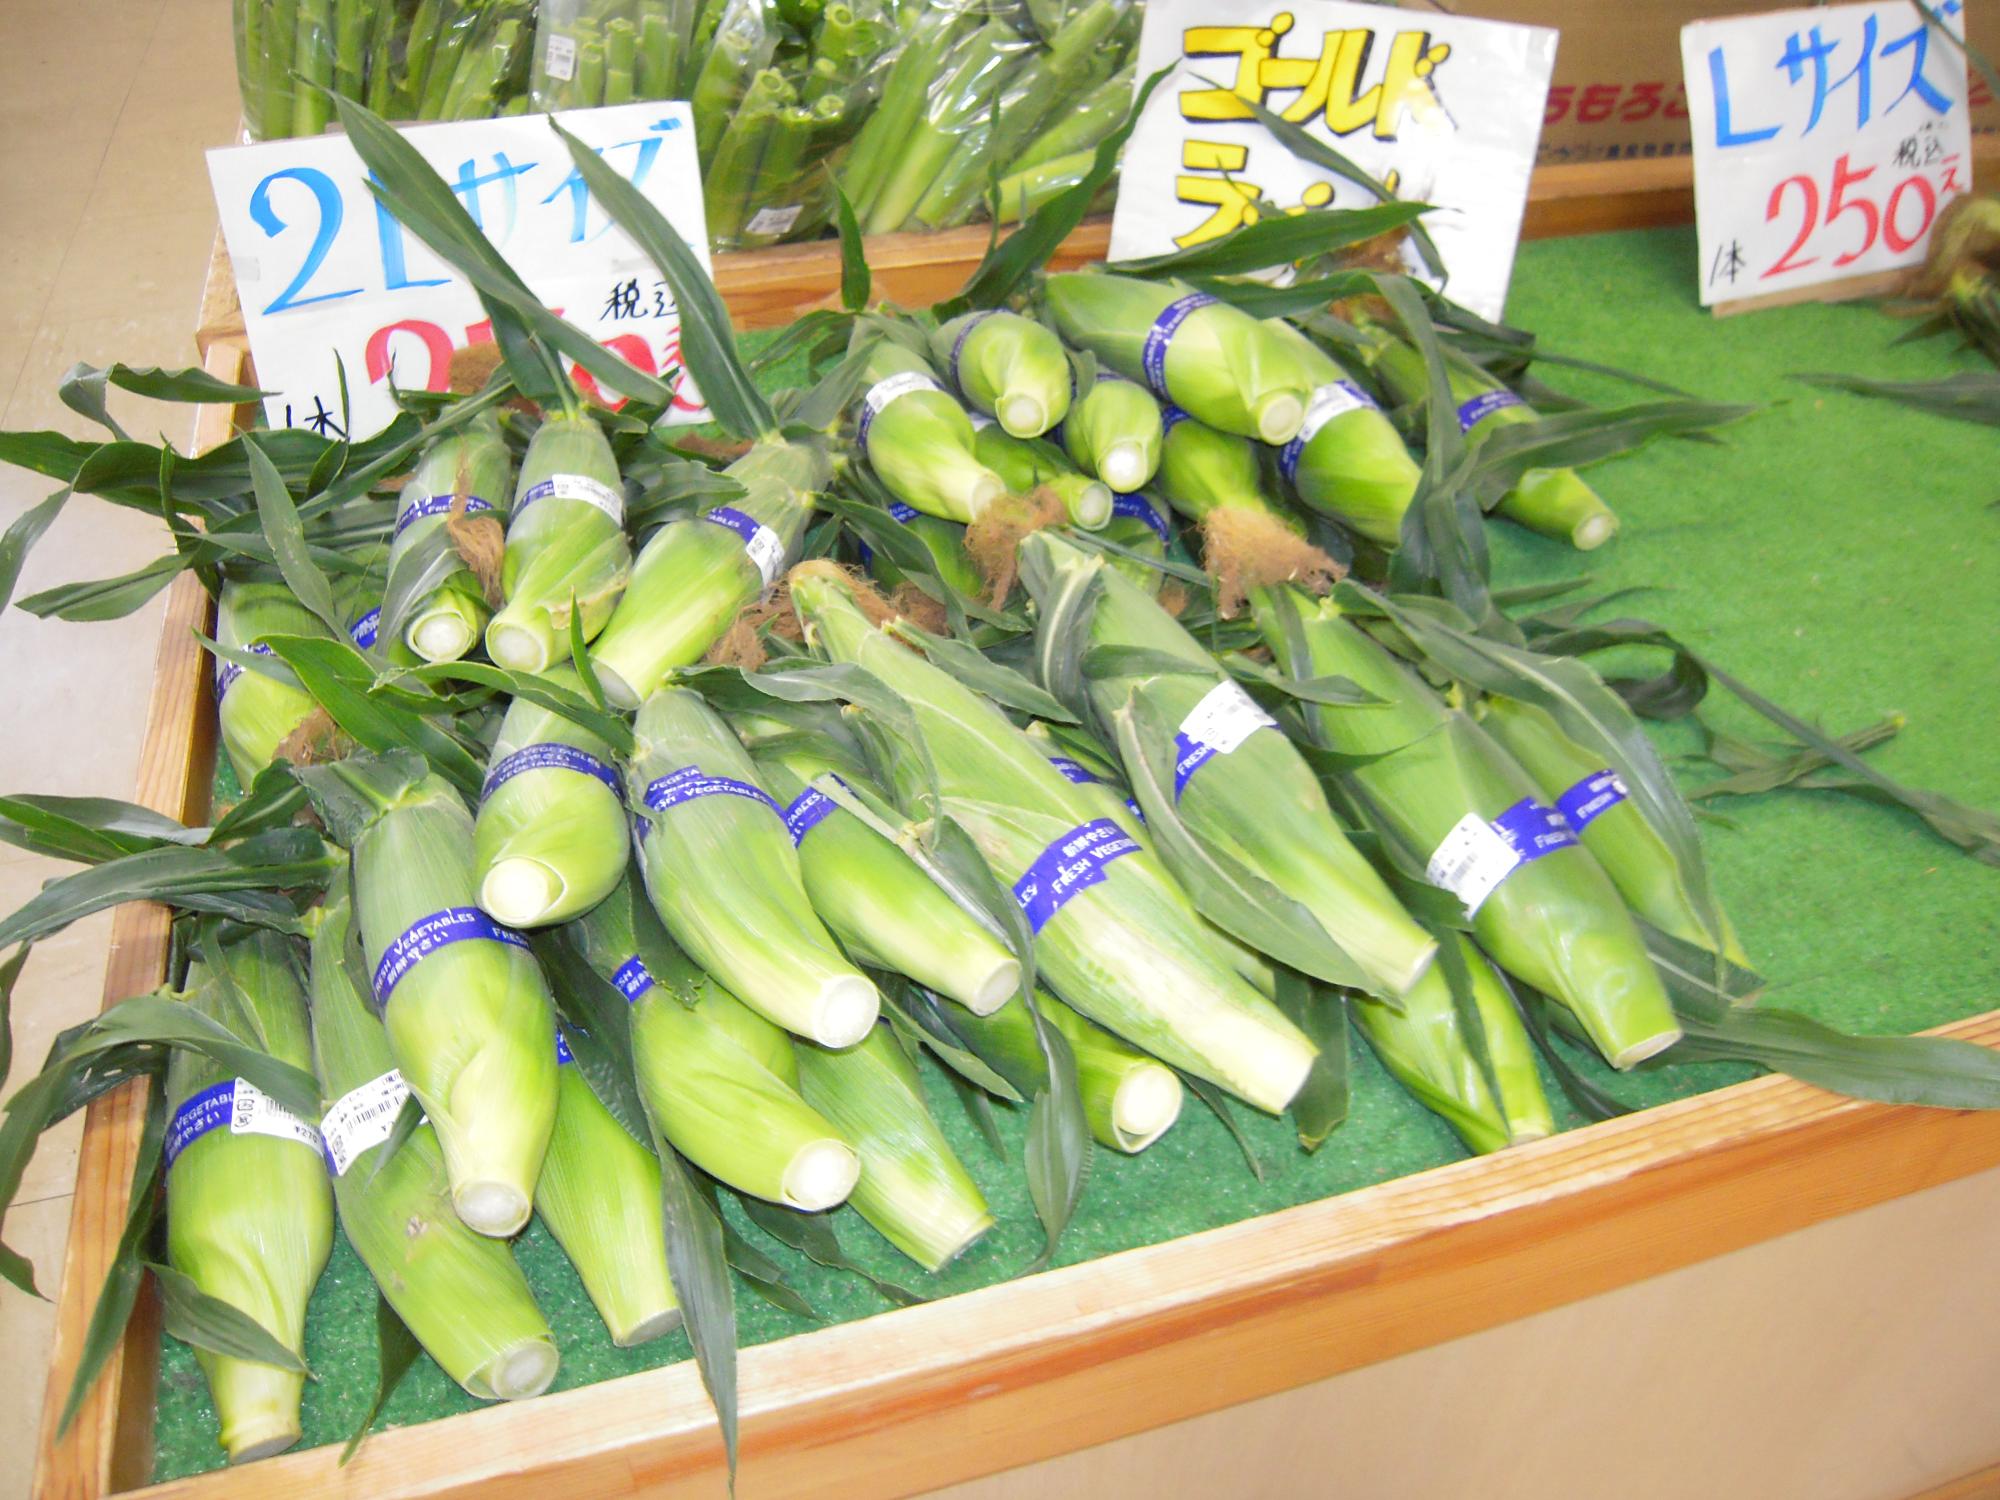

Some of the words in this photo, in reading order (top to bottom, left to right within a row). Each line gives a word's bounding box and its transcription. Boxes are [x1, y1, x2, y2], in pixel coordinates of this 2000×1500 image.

[1179, 11, 1461, 143] ゴールド
[394, 907, 476, 956] VEGETABLES
